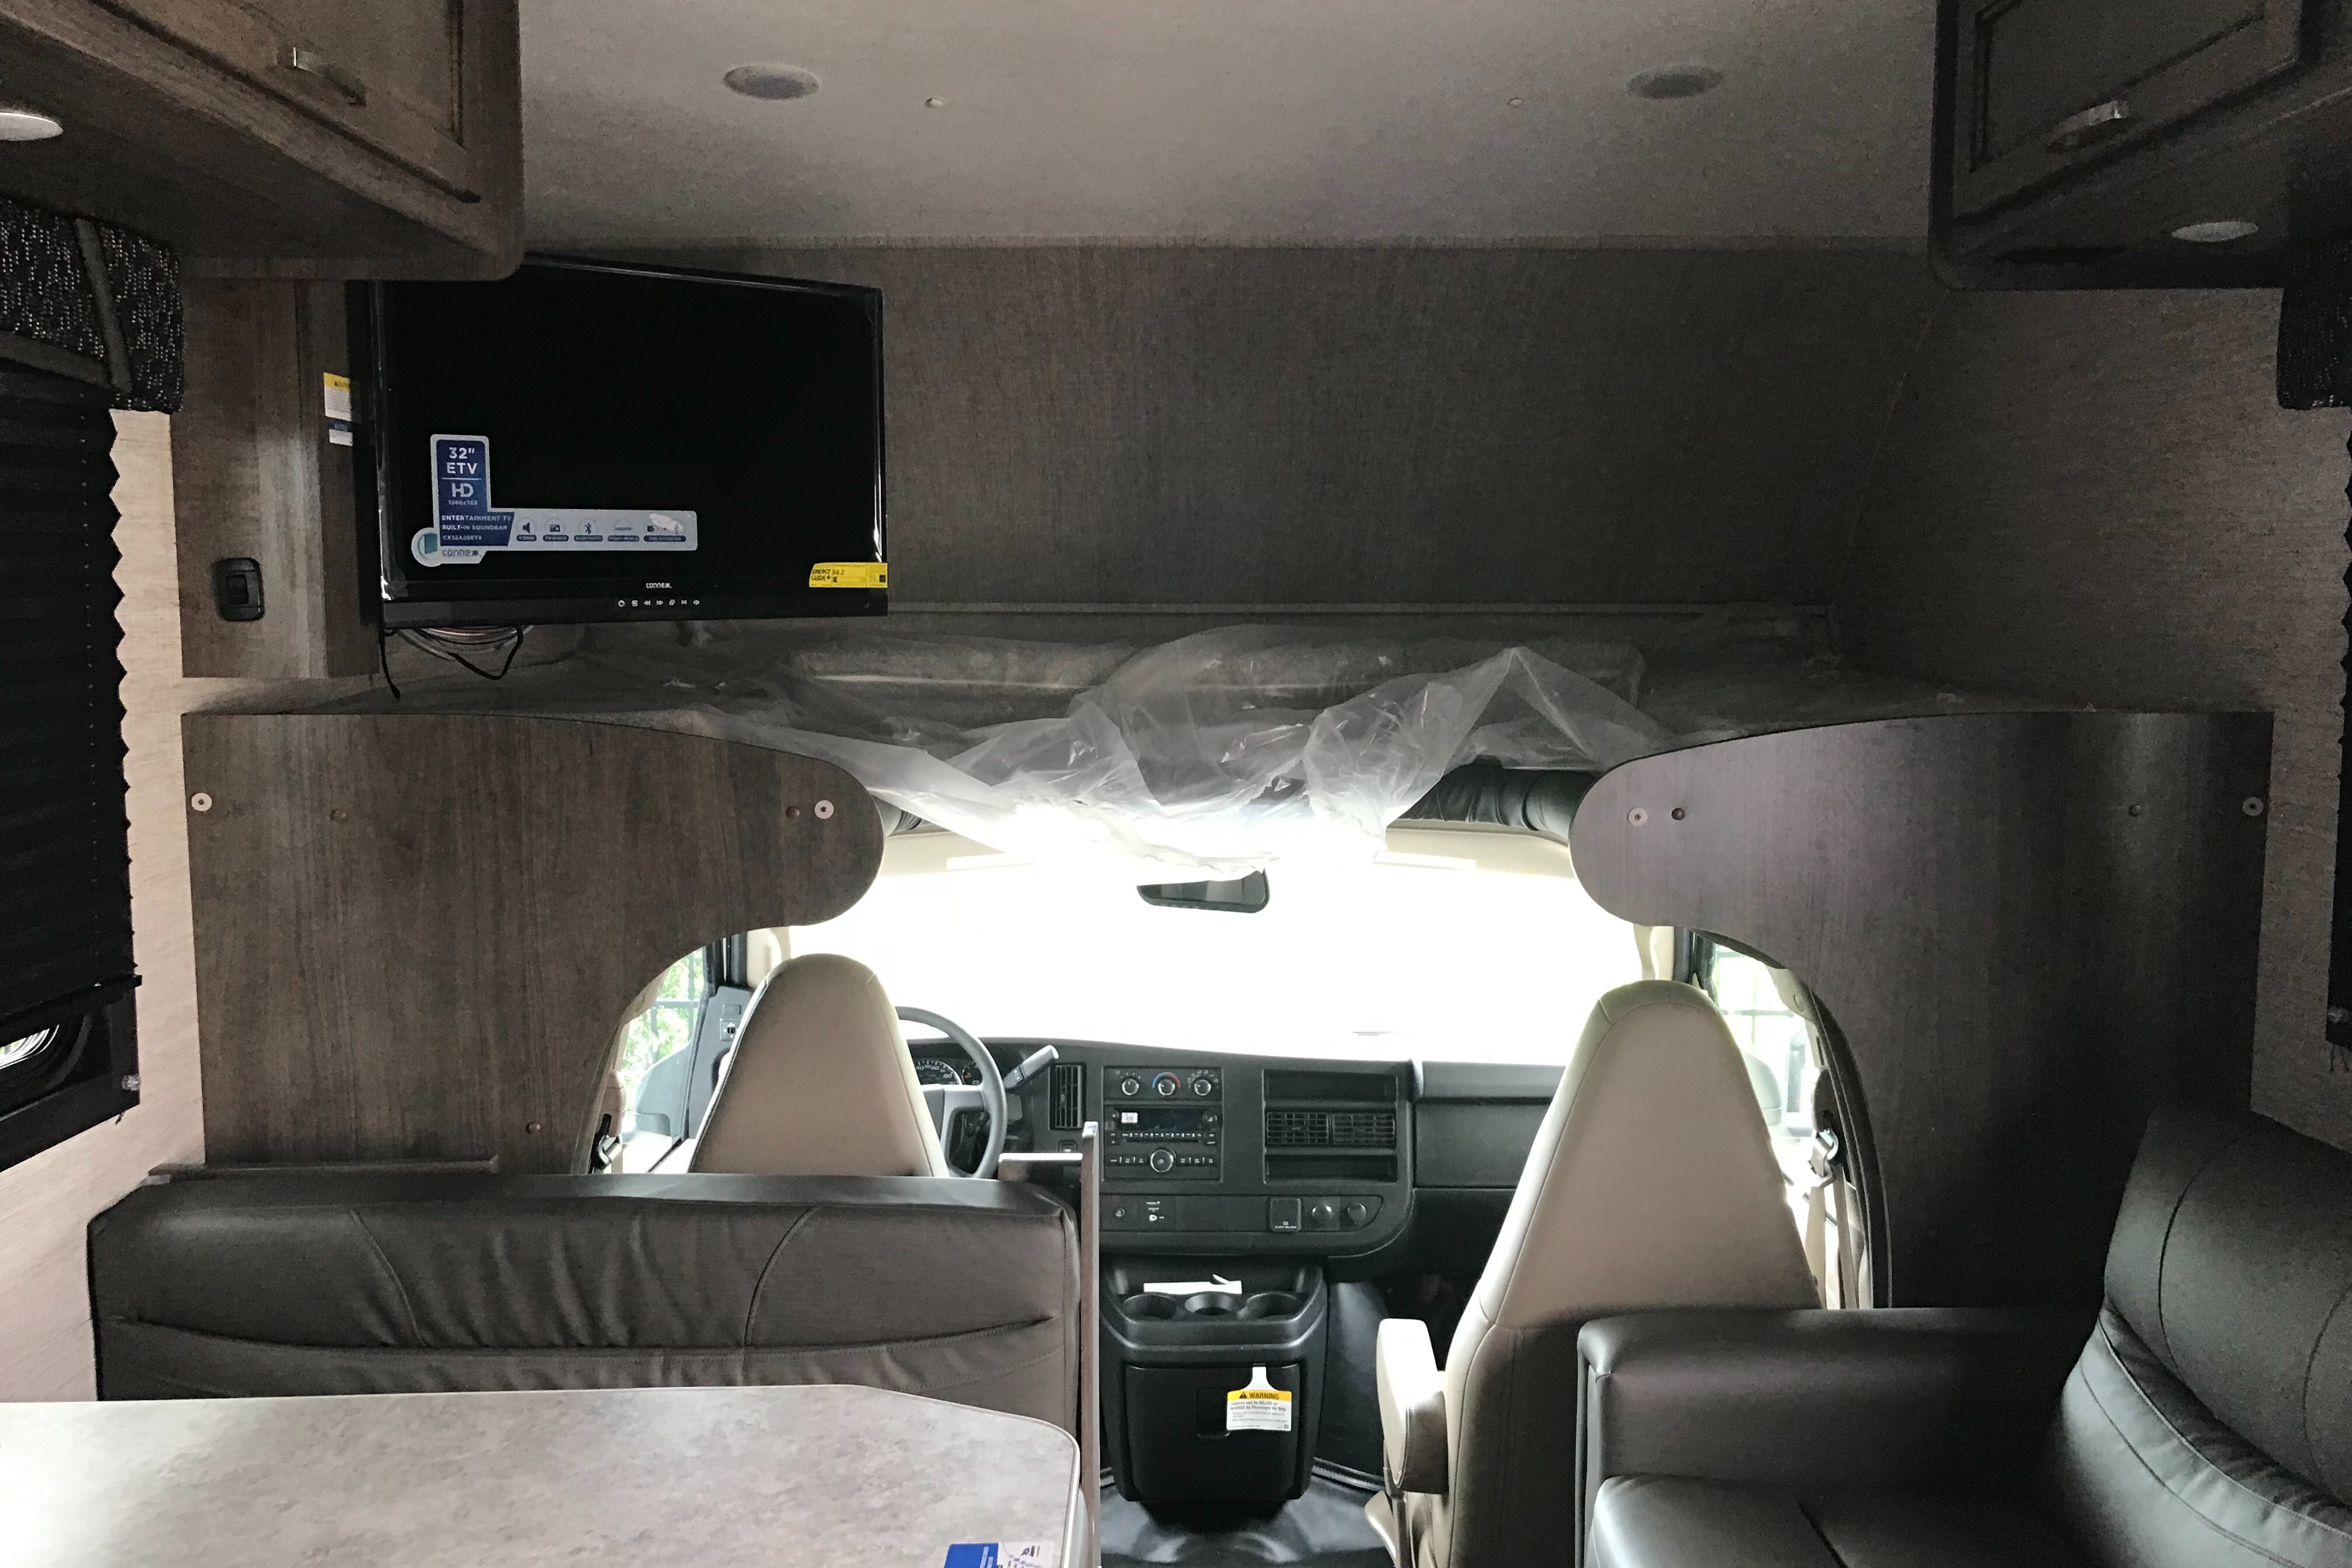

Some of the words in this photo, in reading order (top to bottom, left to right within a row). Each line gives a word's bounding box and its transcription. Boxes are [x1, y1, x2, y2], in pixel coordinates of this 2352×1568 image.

[449, 447, 475, 459] 32"
[446, 462, 478, 474] ETV
[452, 483, 474, 497] HD
